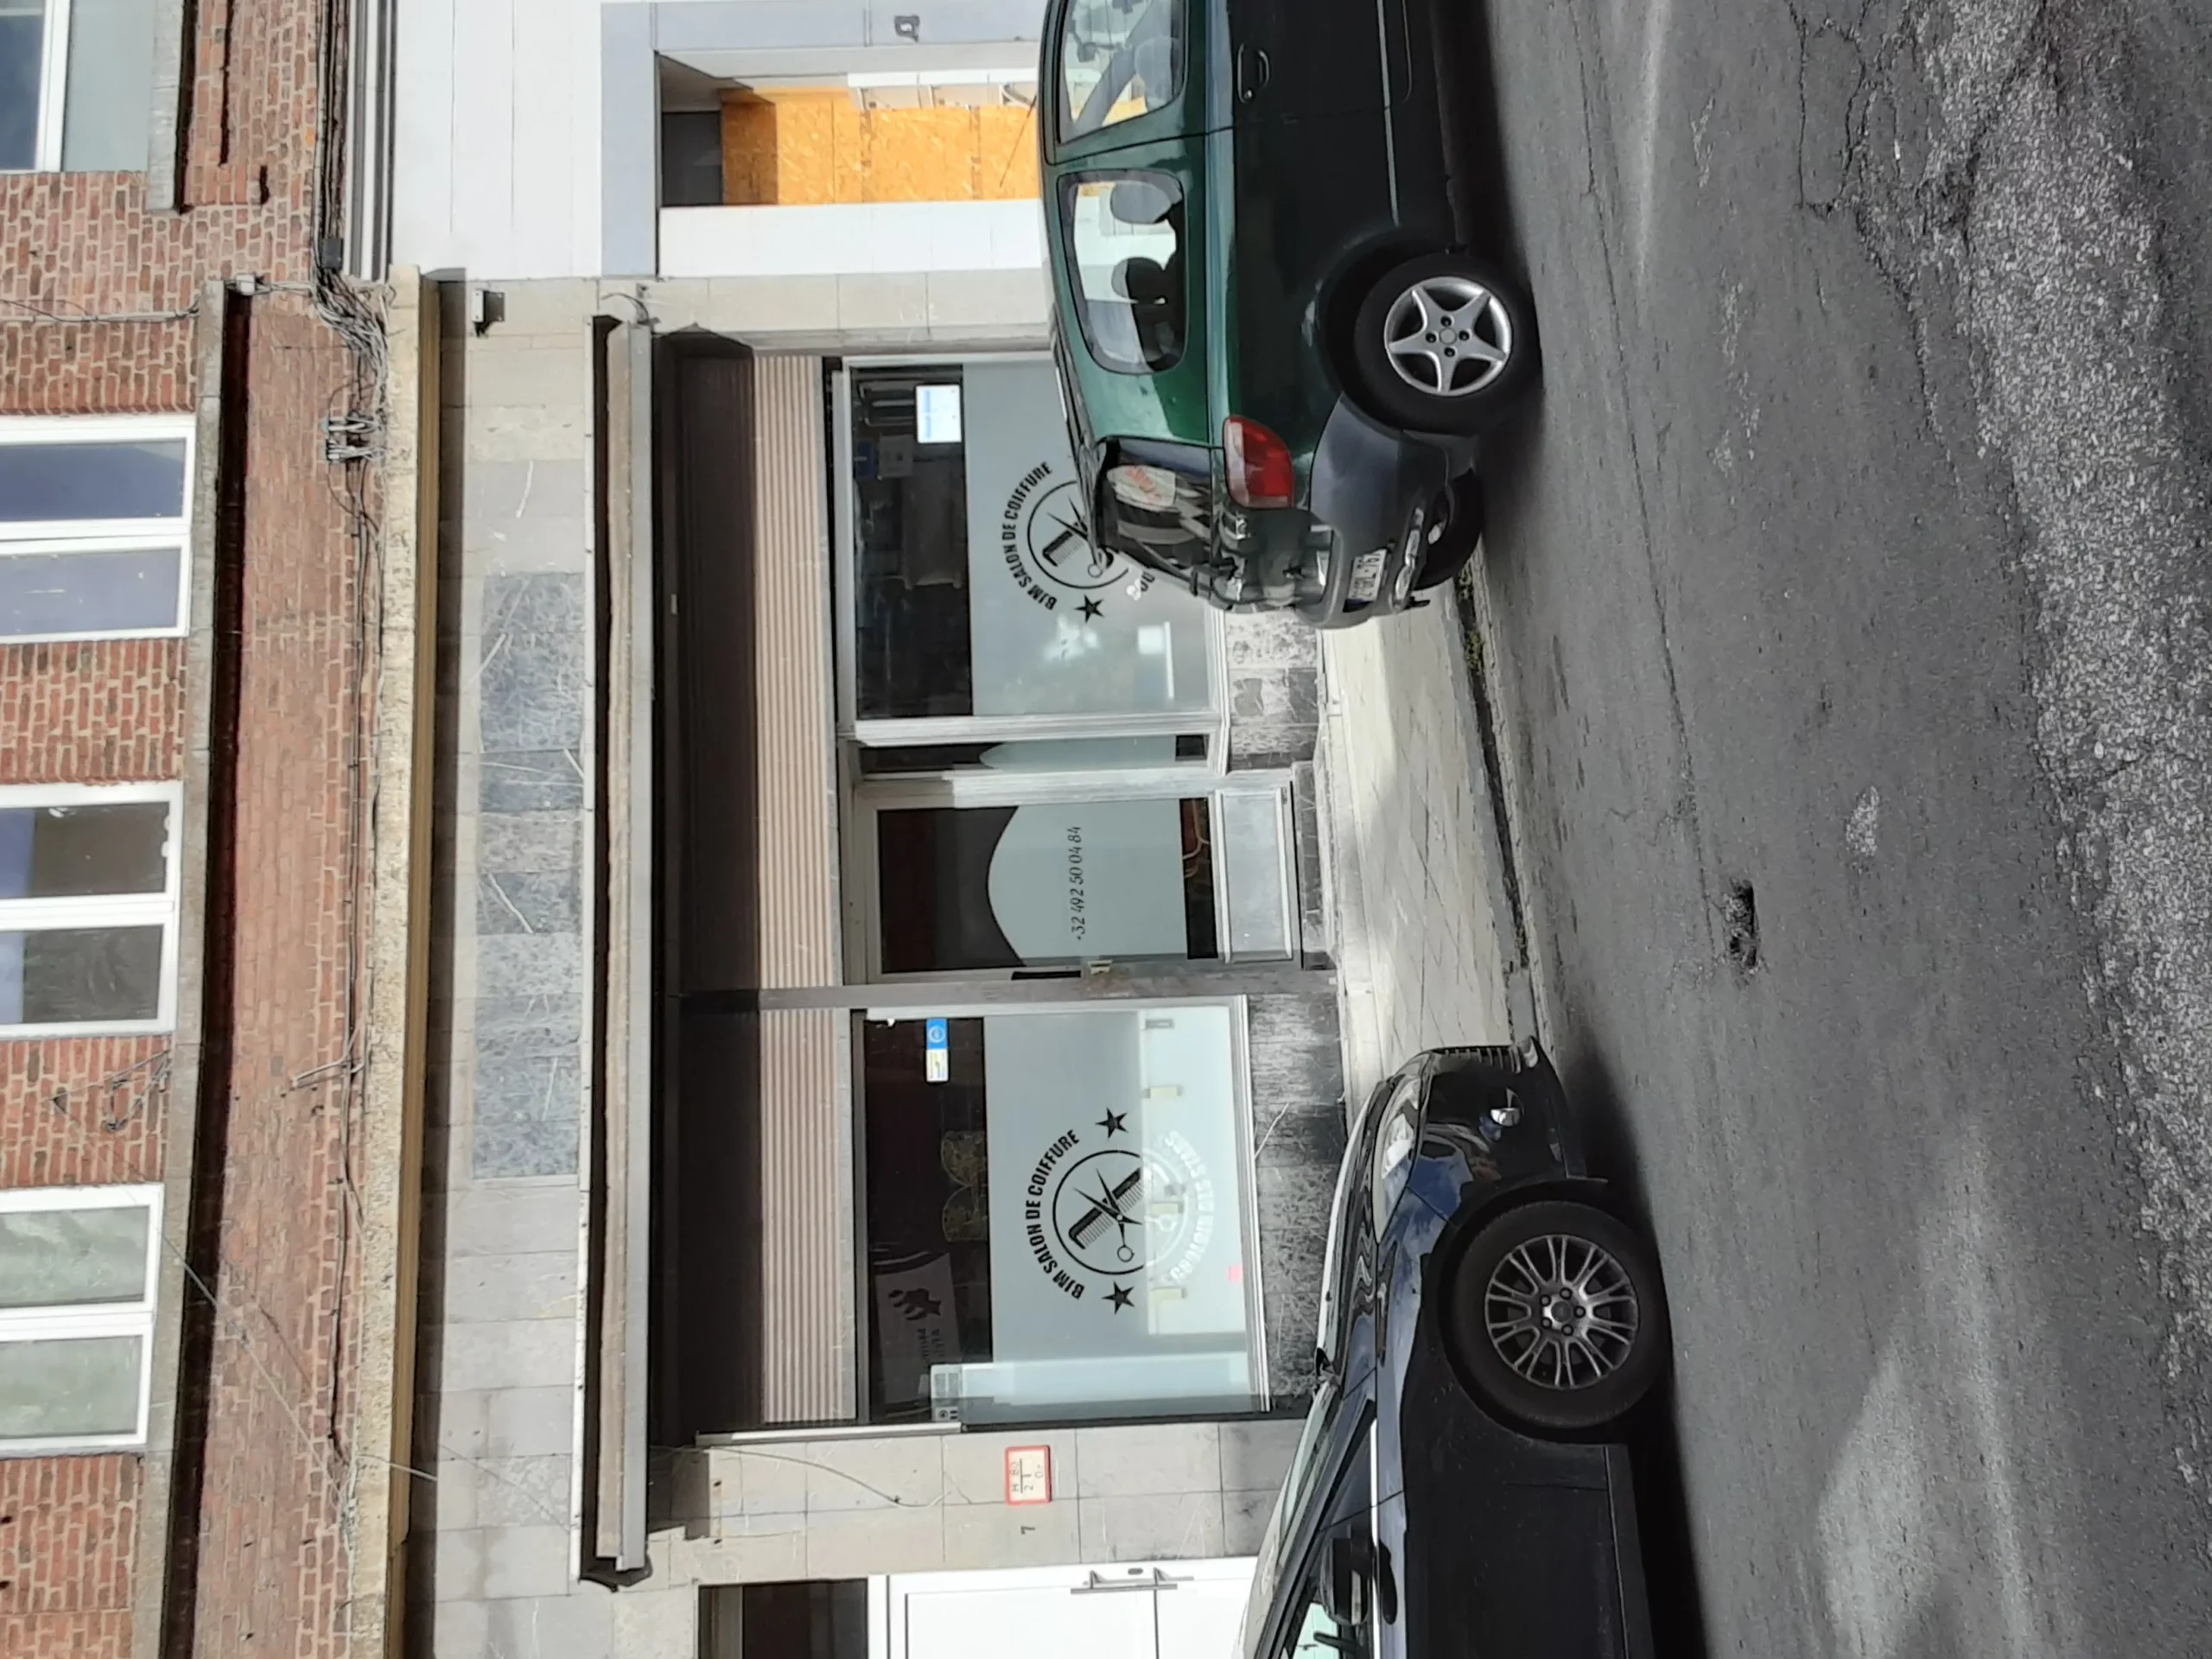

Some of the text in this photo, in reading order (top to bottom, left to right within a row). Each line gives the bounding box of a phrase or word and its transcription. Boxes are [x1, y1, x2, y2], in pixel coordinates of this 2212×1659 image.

[1001, 461, 1058, 610] BJM SALON DE COIFFURE
[1065, 826, 1083, 843] 84
[1067, 846, 1083, 864] 04
[1068, 866, 1084, 885] 50
[1069, 887, 1084, 912] 492
[1025, 1128, 1085, 1300] BJM SALON DE COIFFURE
[1020, 1525, 1036, 1535] 7
